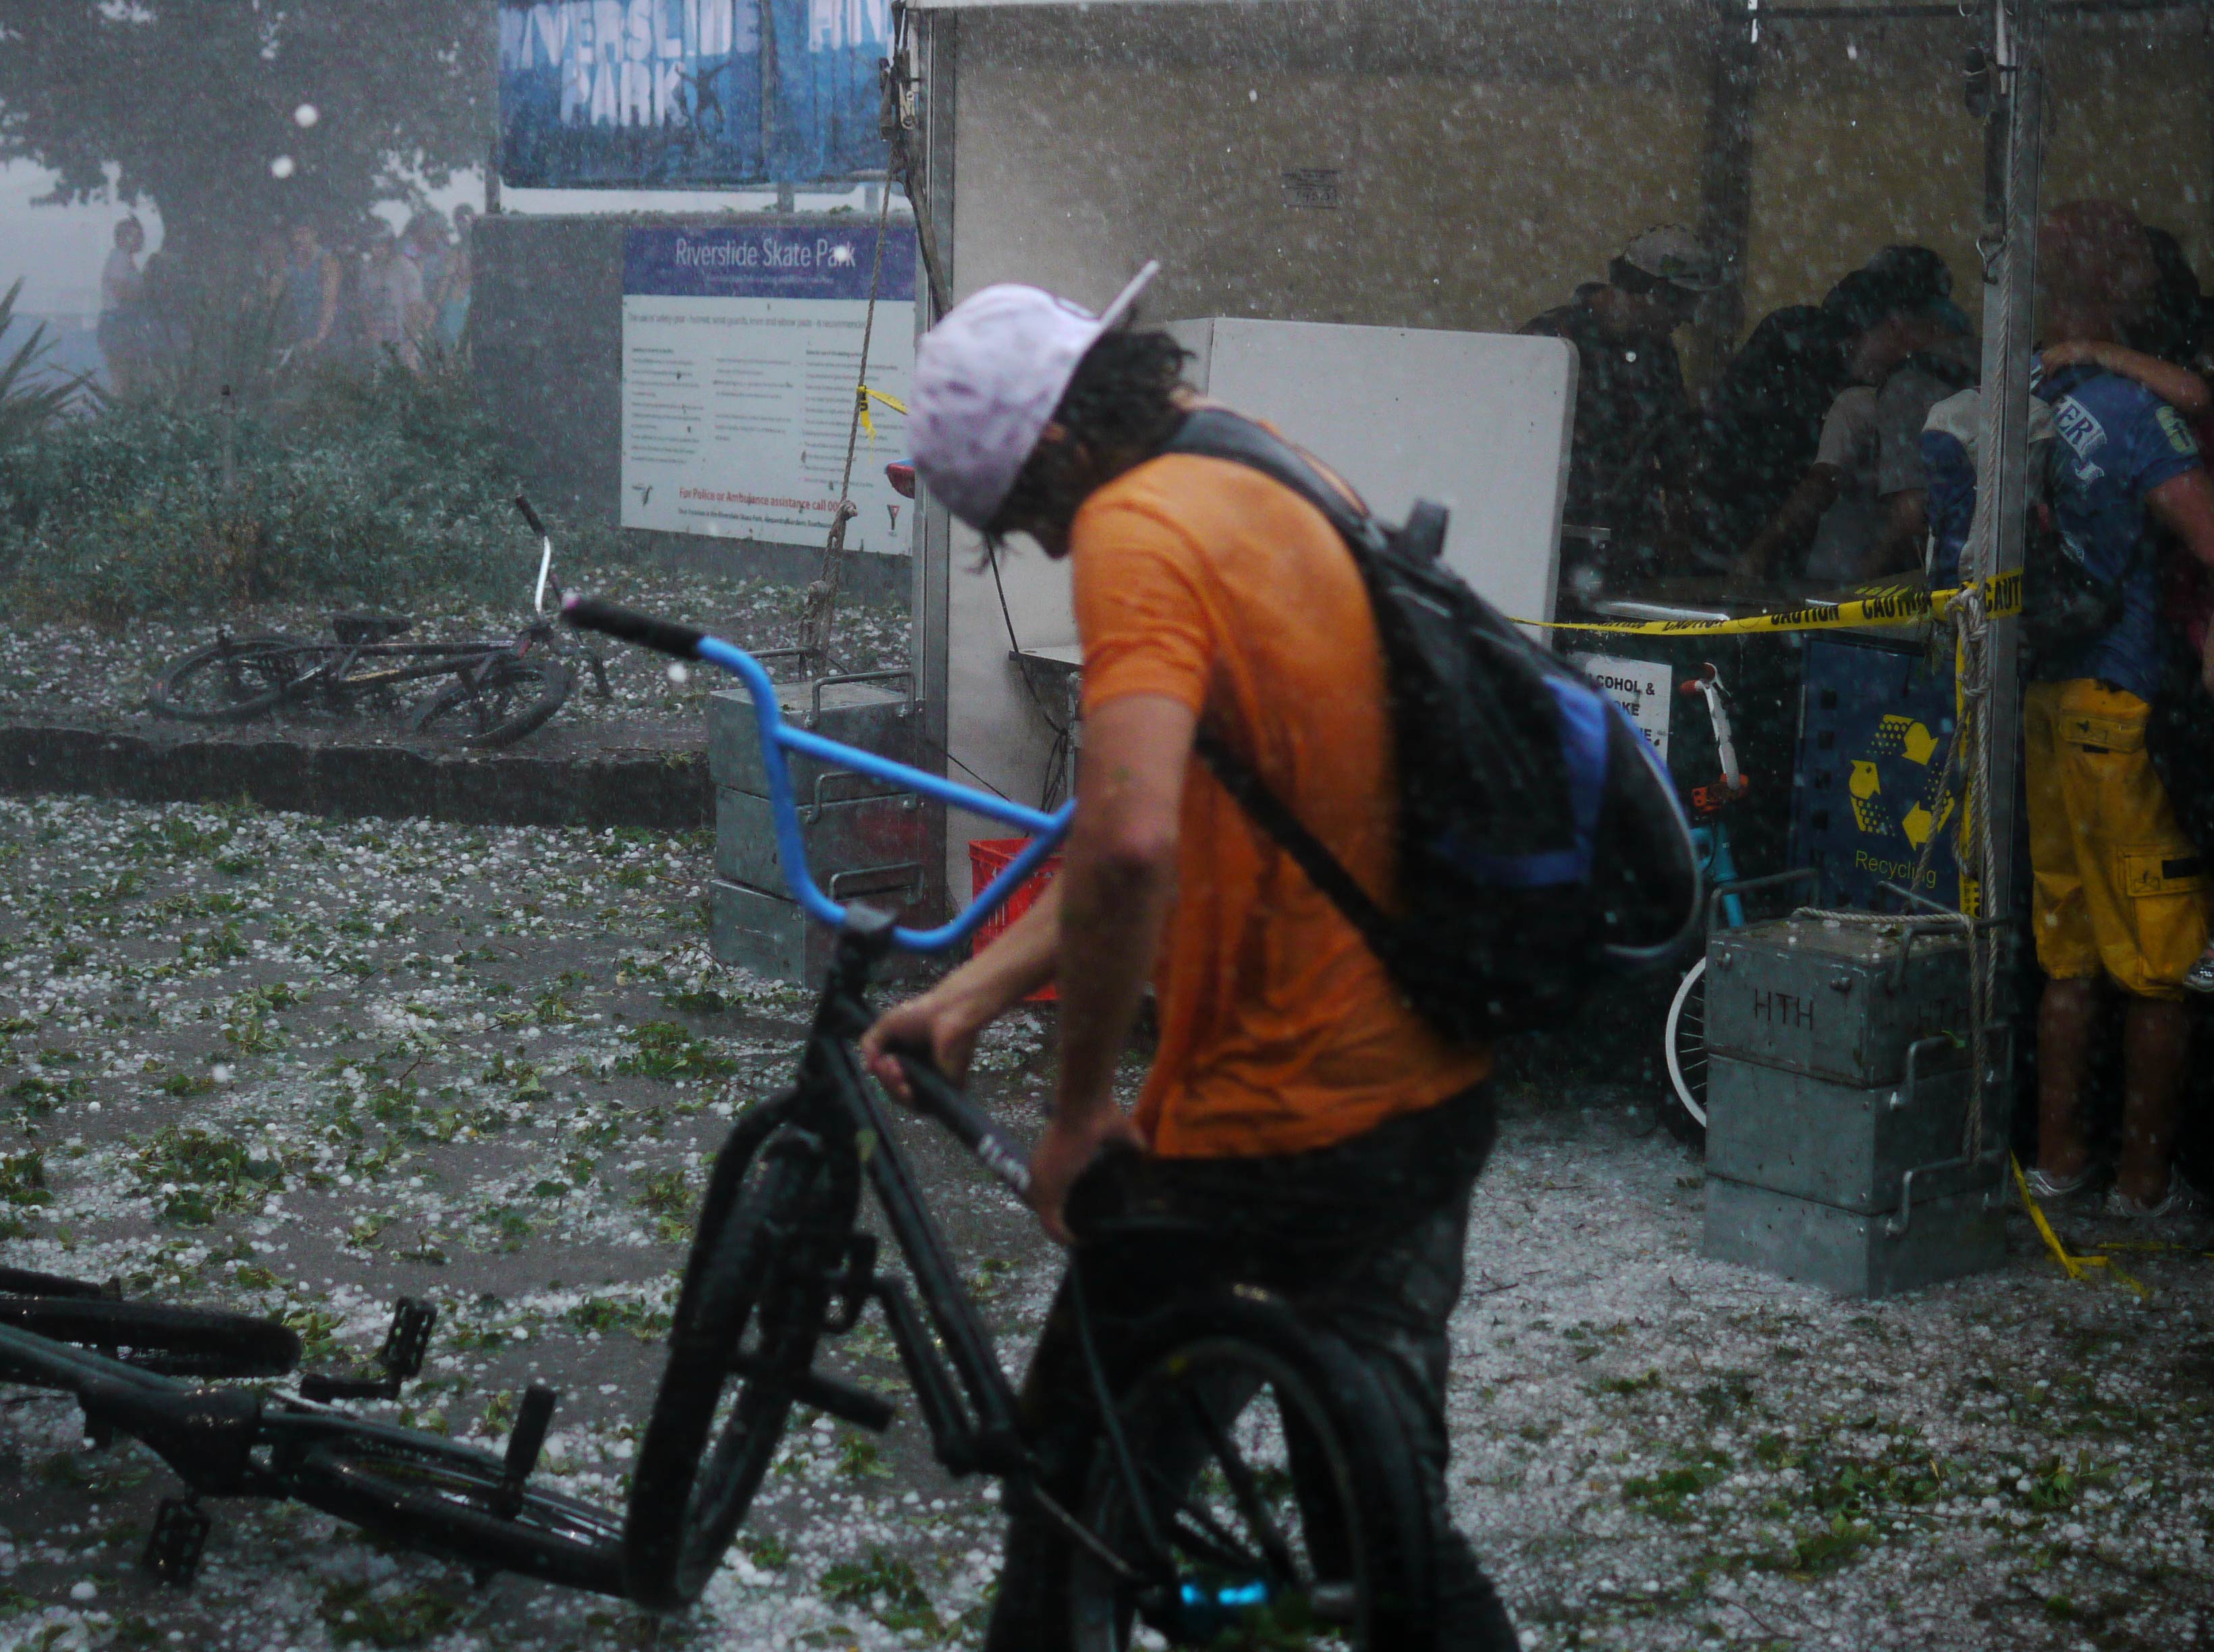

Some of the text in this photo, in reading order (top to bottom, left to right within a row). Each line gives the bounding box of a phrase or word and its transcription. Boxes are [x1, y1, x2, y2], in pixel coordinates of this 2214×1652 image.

[561, 59, 689, 128] PARK
[676, 237, 758, 267] Riverslide
[763, 237, 811, 267] Skate
[679, 486, 692, 499] For
[693, 487, 716, 501] Police
[717, 492, 725, 501] or
[726, 491, 769, 506] Ambulance
[770, 496, 810, 510] assistance
[812, 499, 826, 512] call
[1771, 604, 1841, 626] CAUTION
[1590, 674, 1655, 696] COHOL &
[1754, 988, 1814, 1031] HTH
